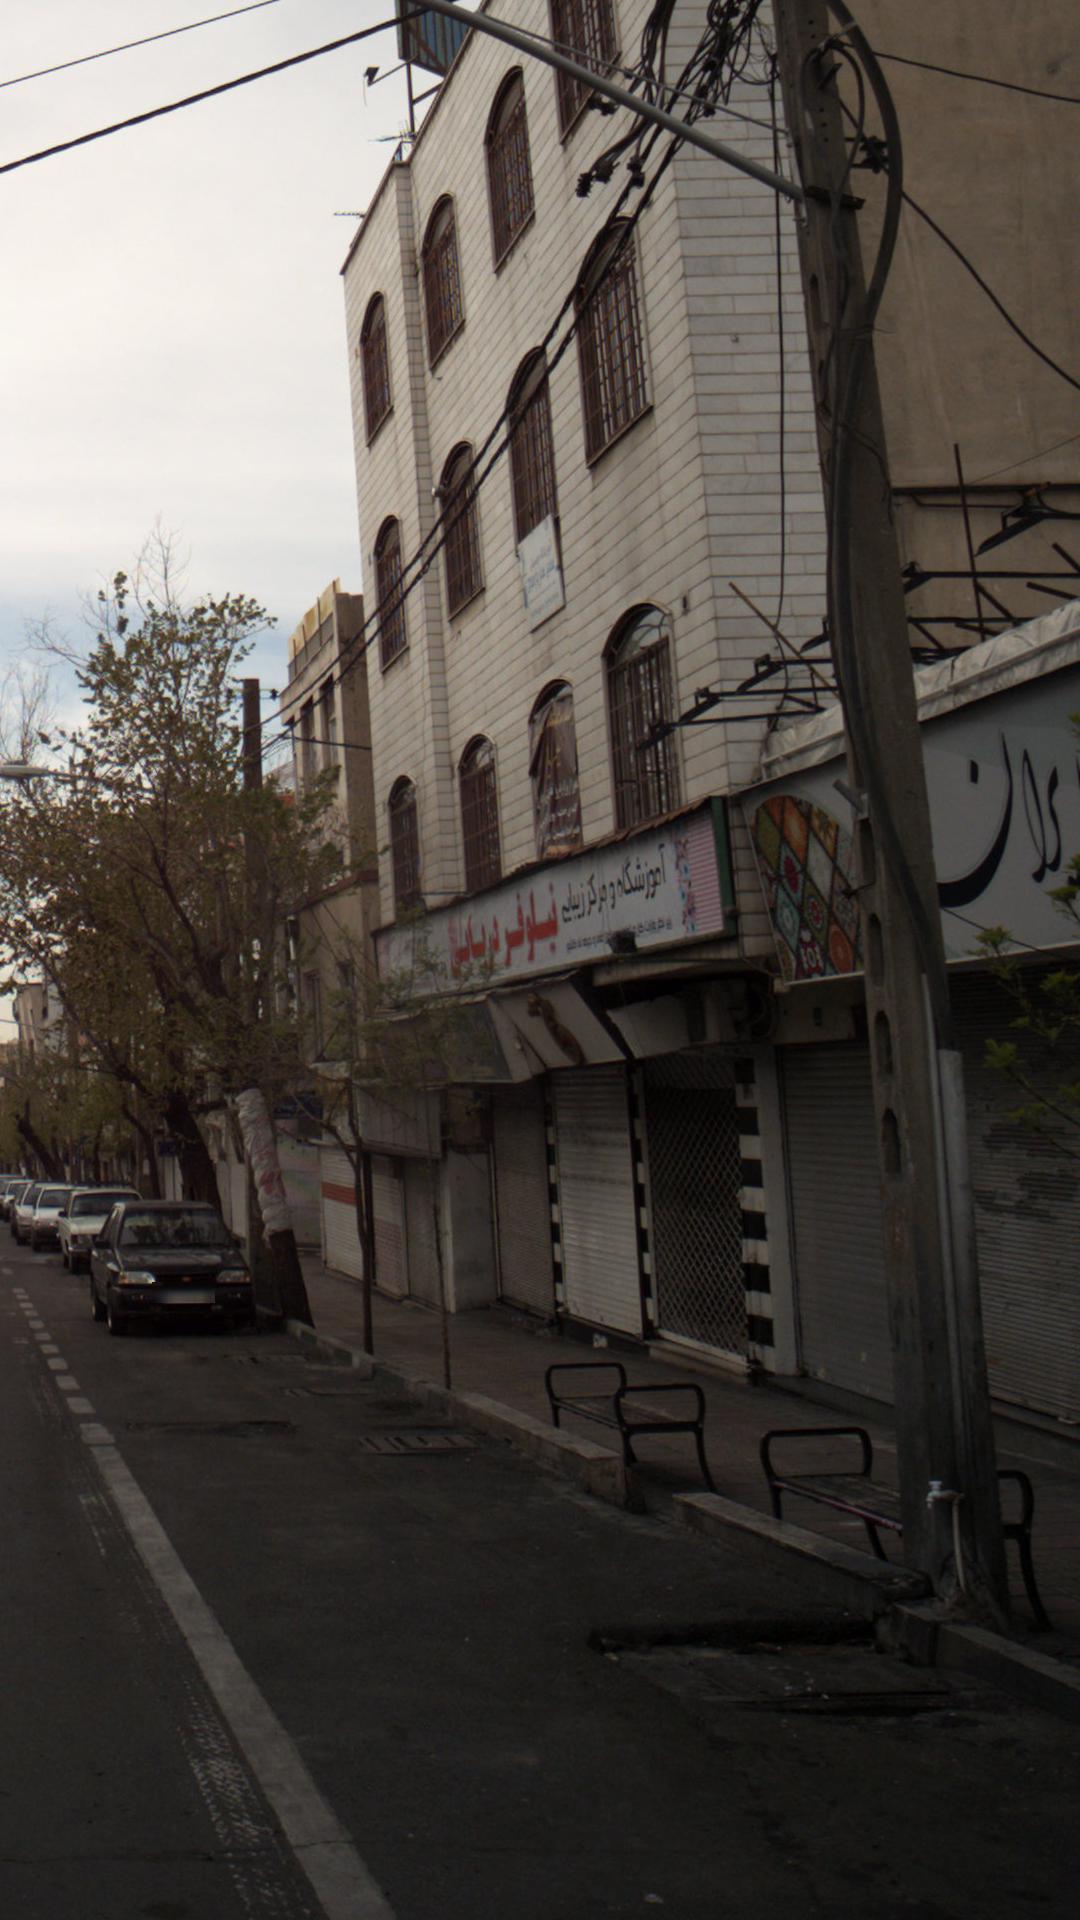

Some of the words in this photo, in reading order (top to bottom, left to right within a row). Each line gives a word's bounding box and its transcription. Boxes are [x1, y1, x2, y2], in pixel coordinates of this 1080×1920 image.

[588, 873, 607, 914] مرکز
[617, 843, 667, 900] آموزشگاه
[561, 880, 588, 924] زیبایی
[608, 881, 616, 909] و
[505, 882, 559, 967] نیلوفر
